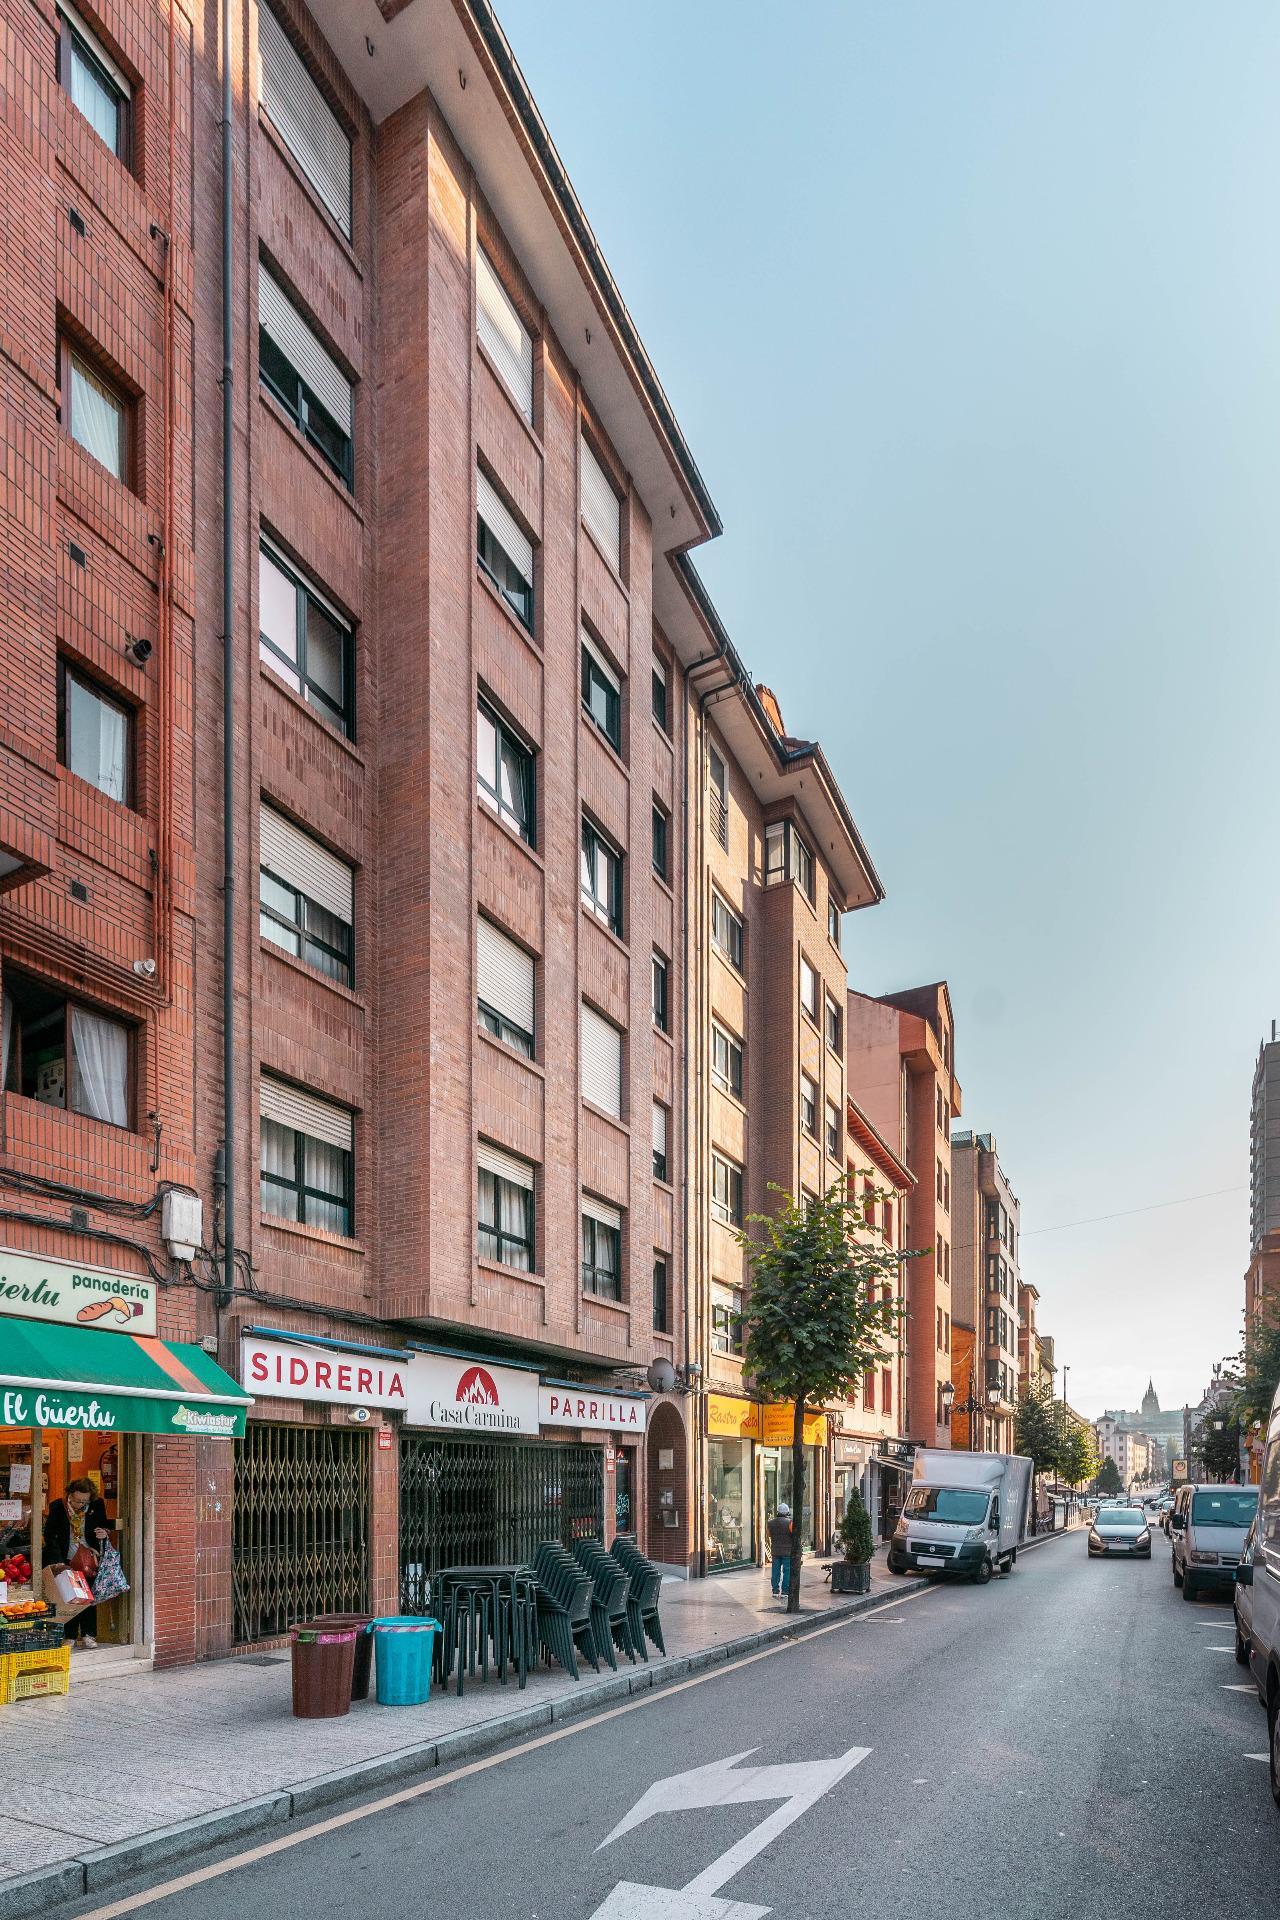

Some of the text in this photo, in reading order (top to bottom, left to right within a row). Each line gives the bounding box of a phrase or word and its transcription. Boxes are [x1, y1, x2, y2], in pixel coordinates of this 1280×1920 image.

[72, 1274, 149, 1299] panadería
[251, 1352, 405, 1398] SIDRERIA
[4, 1391, 115, 1428] El Güertu
[187, 1411, 234, 1427] Kiwiastur
[430, 1400, 521, 1429] Casa Carmina
[550, 1395, 637, 1424] PARRILLA
[709, 1404, 737, 1425] Rastro
